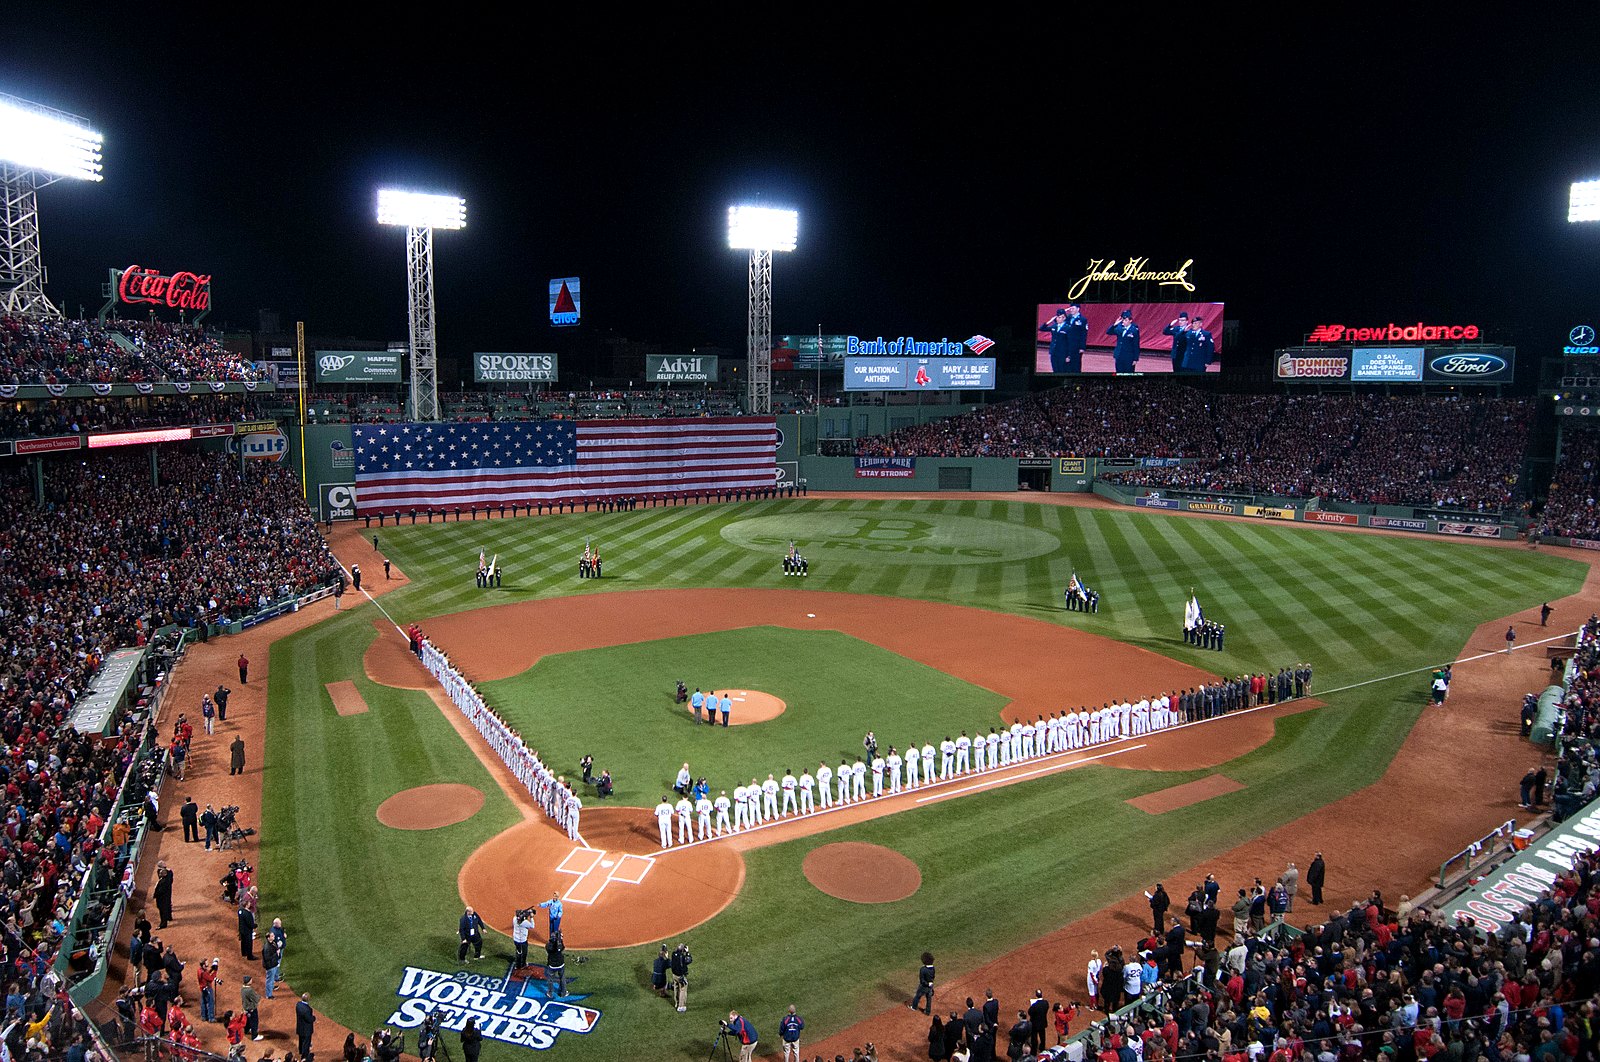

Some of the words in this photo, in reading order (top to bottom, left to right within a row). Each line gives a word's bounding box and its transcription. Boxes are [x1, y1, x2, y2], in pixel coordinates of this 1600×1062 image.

[1067, 258, 1119, 300] John
[1118, 256, 1196, 292] Hancock
[119, 264, 211, 310] Coca-Cola
[552, 313, 578, 324] CITGO
[1388, 322, 1479, 341] balance
[846, 336, 887, 355] Bank
[888, 336, 904, 355] of
[904, 336, 963, 356] America
[321, 355, 343, 370] AAA
[480, 355, 552, 370] SPORTS
[657, 357, 702, 372] Advil
[854, 366, 868, 374] OUR
[868, 366, 900, 374] NATIONAL
[942, 365, 961, 374] MARY
[963, 365, 970, 374] J.
[971, 365, 989, 374] BLIGE
[1443, 356, 1491, 373] Ford
[480, 370, 552, 380] AUTHORITY
[1297, 367, 1344, 375] DONUTS
[864, 375, 890, 383] ANTHEM
[230, 438, 284, 453] Gulf
[1145, 498, 1168, 507] jetBlue
[1255, 508, 1282, 517] Nikon
[1316, 512, 1346, 523] xfinity
[1402, 520, 1426, 528] TICKET
[1452, 862, 1556, 934] BOSTON
[451, 970, 504, 991] 2013
[1130, 969, 1141, 978] 23
[398, 965, 544, 1021] WORLD
[386, 998, 561, 1050] SERIES
